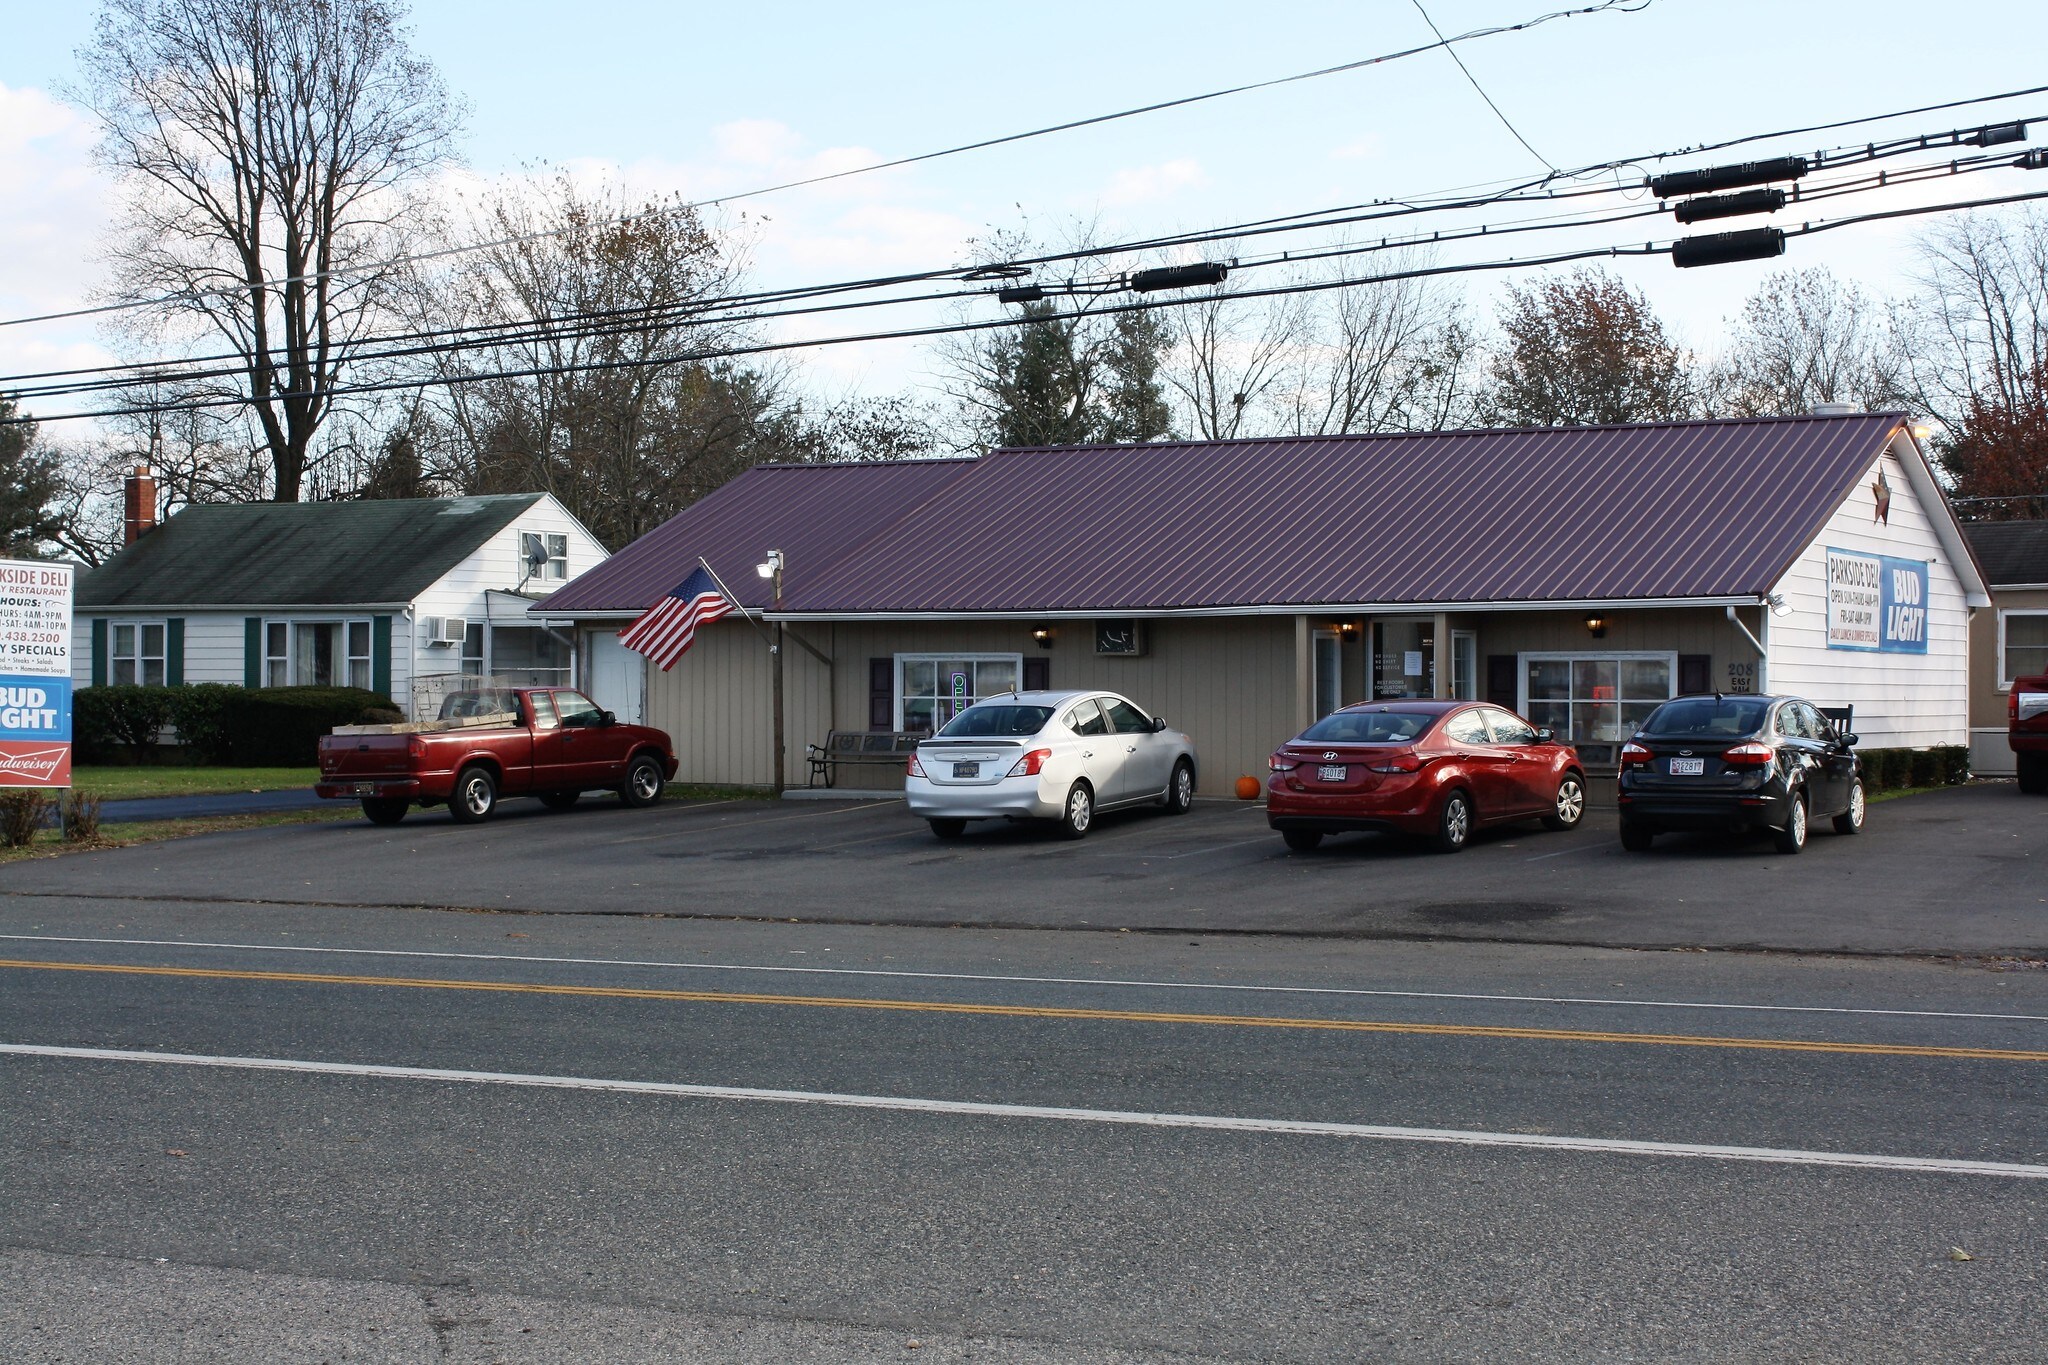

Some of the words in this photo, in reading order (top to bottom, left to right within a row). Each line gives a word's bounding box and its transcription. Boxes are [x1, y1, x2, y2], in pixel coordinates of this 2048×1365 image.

[41, 571, 68, 587] DELI
[1830, 557, 1865, 587] PARKSIDE
[1865, 562, 1879, 589] DELI
[9, 585, 67, 597] RESTAURANT
[1892, 569, 1921, 605] BUD
[0, 597, 41, 608] HOURS:
[1831, 589, 1843, 604] OPEN
[24, 610, 63, 620] 4AM-9PM
[24, 620, 67, 631] 4AM-10PM
[1886, 605, 1925, 642] LIGHT
[0, 631, 60, 643] .438.2500
[11, 644, 66, 657] SPECIALS
[12, 656, 30, 664] Steaks
[20, 665, 50, 673] Homemade
[1728, 662, 1754, 676] 208
[0, 707, 58, 729] GHT
